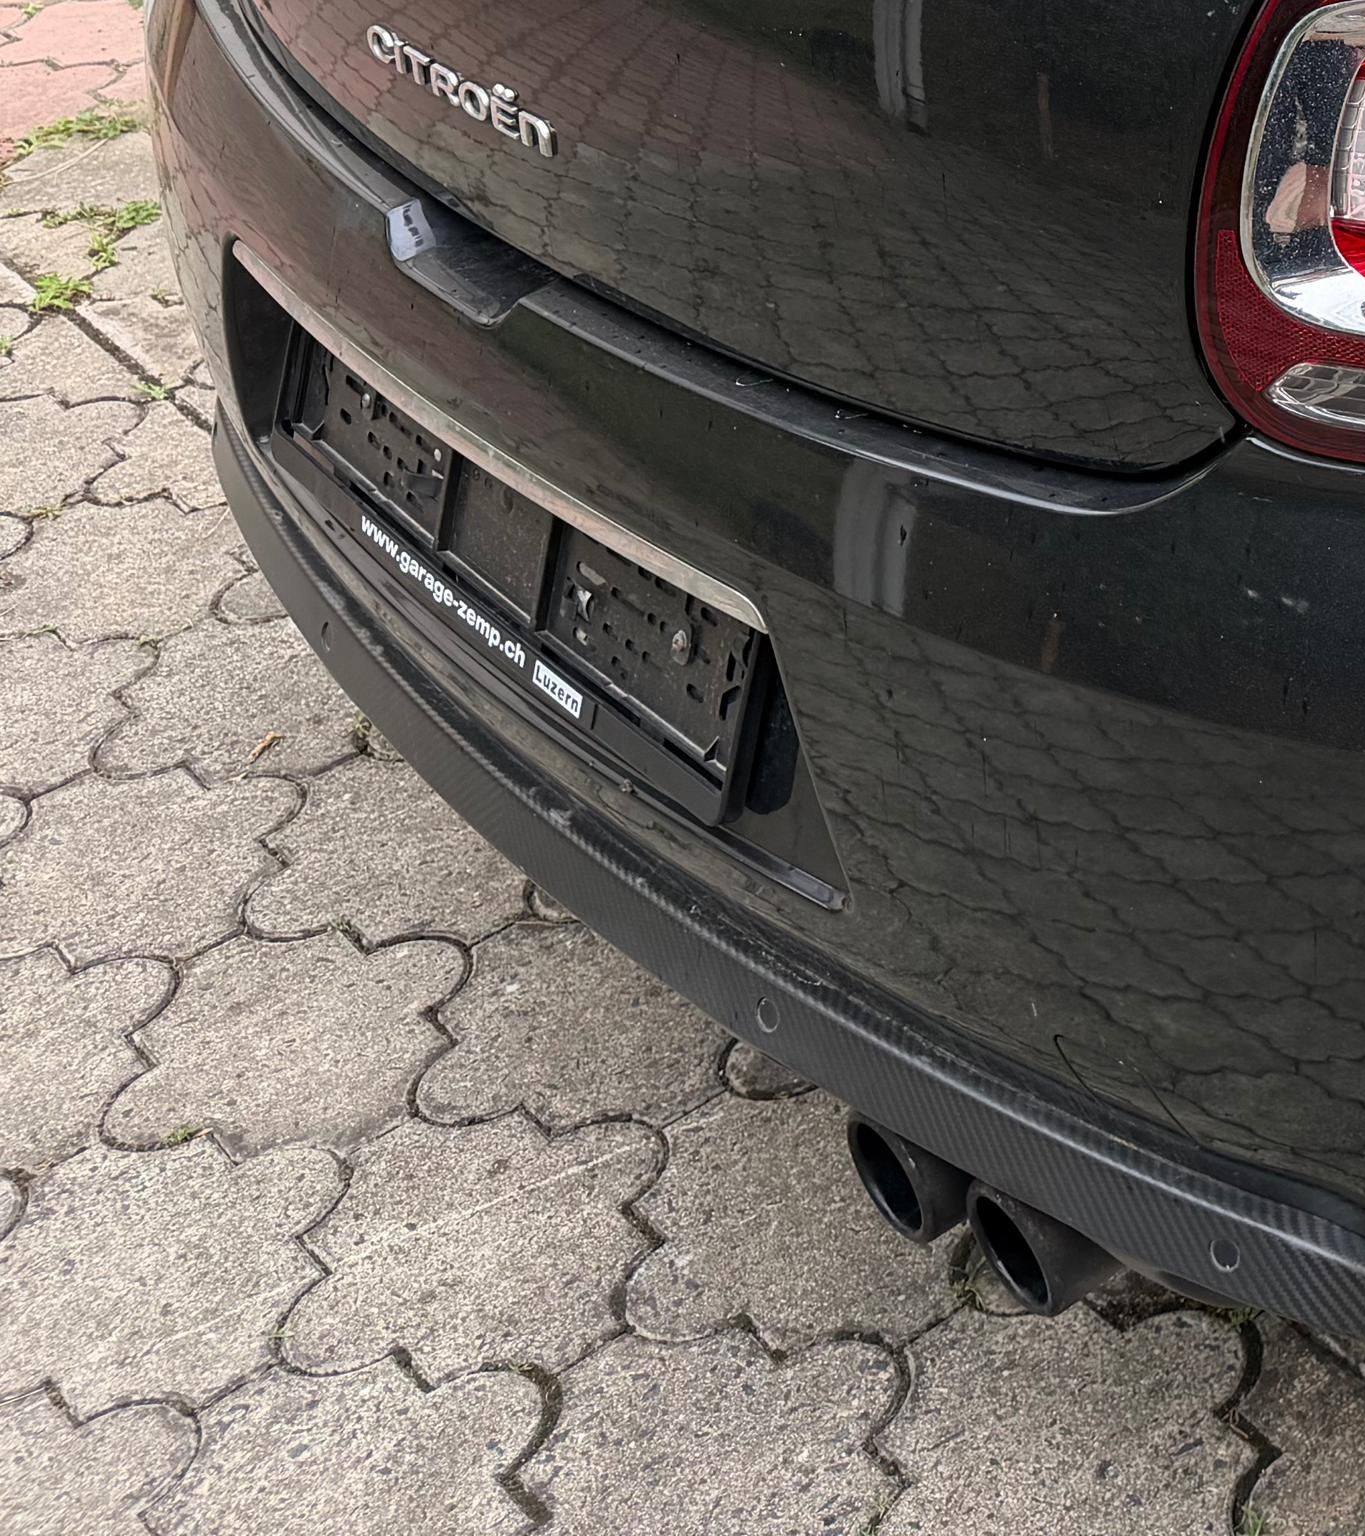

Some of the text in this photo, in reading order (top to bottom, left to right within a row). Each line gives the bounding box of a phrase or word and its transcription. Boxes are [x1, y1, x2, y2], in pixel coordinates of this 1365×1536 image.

[367, 24, 558, 158] CITROËN
[360, 515, 580, 714] www.garage-zemp.ch Luzern
